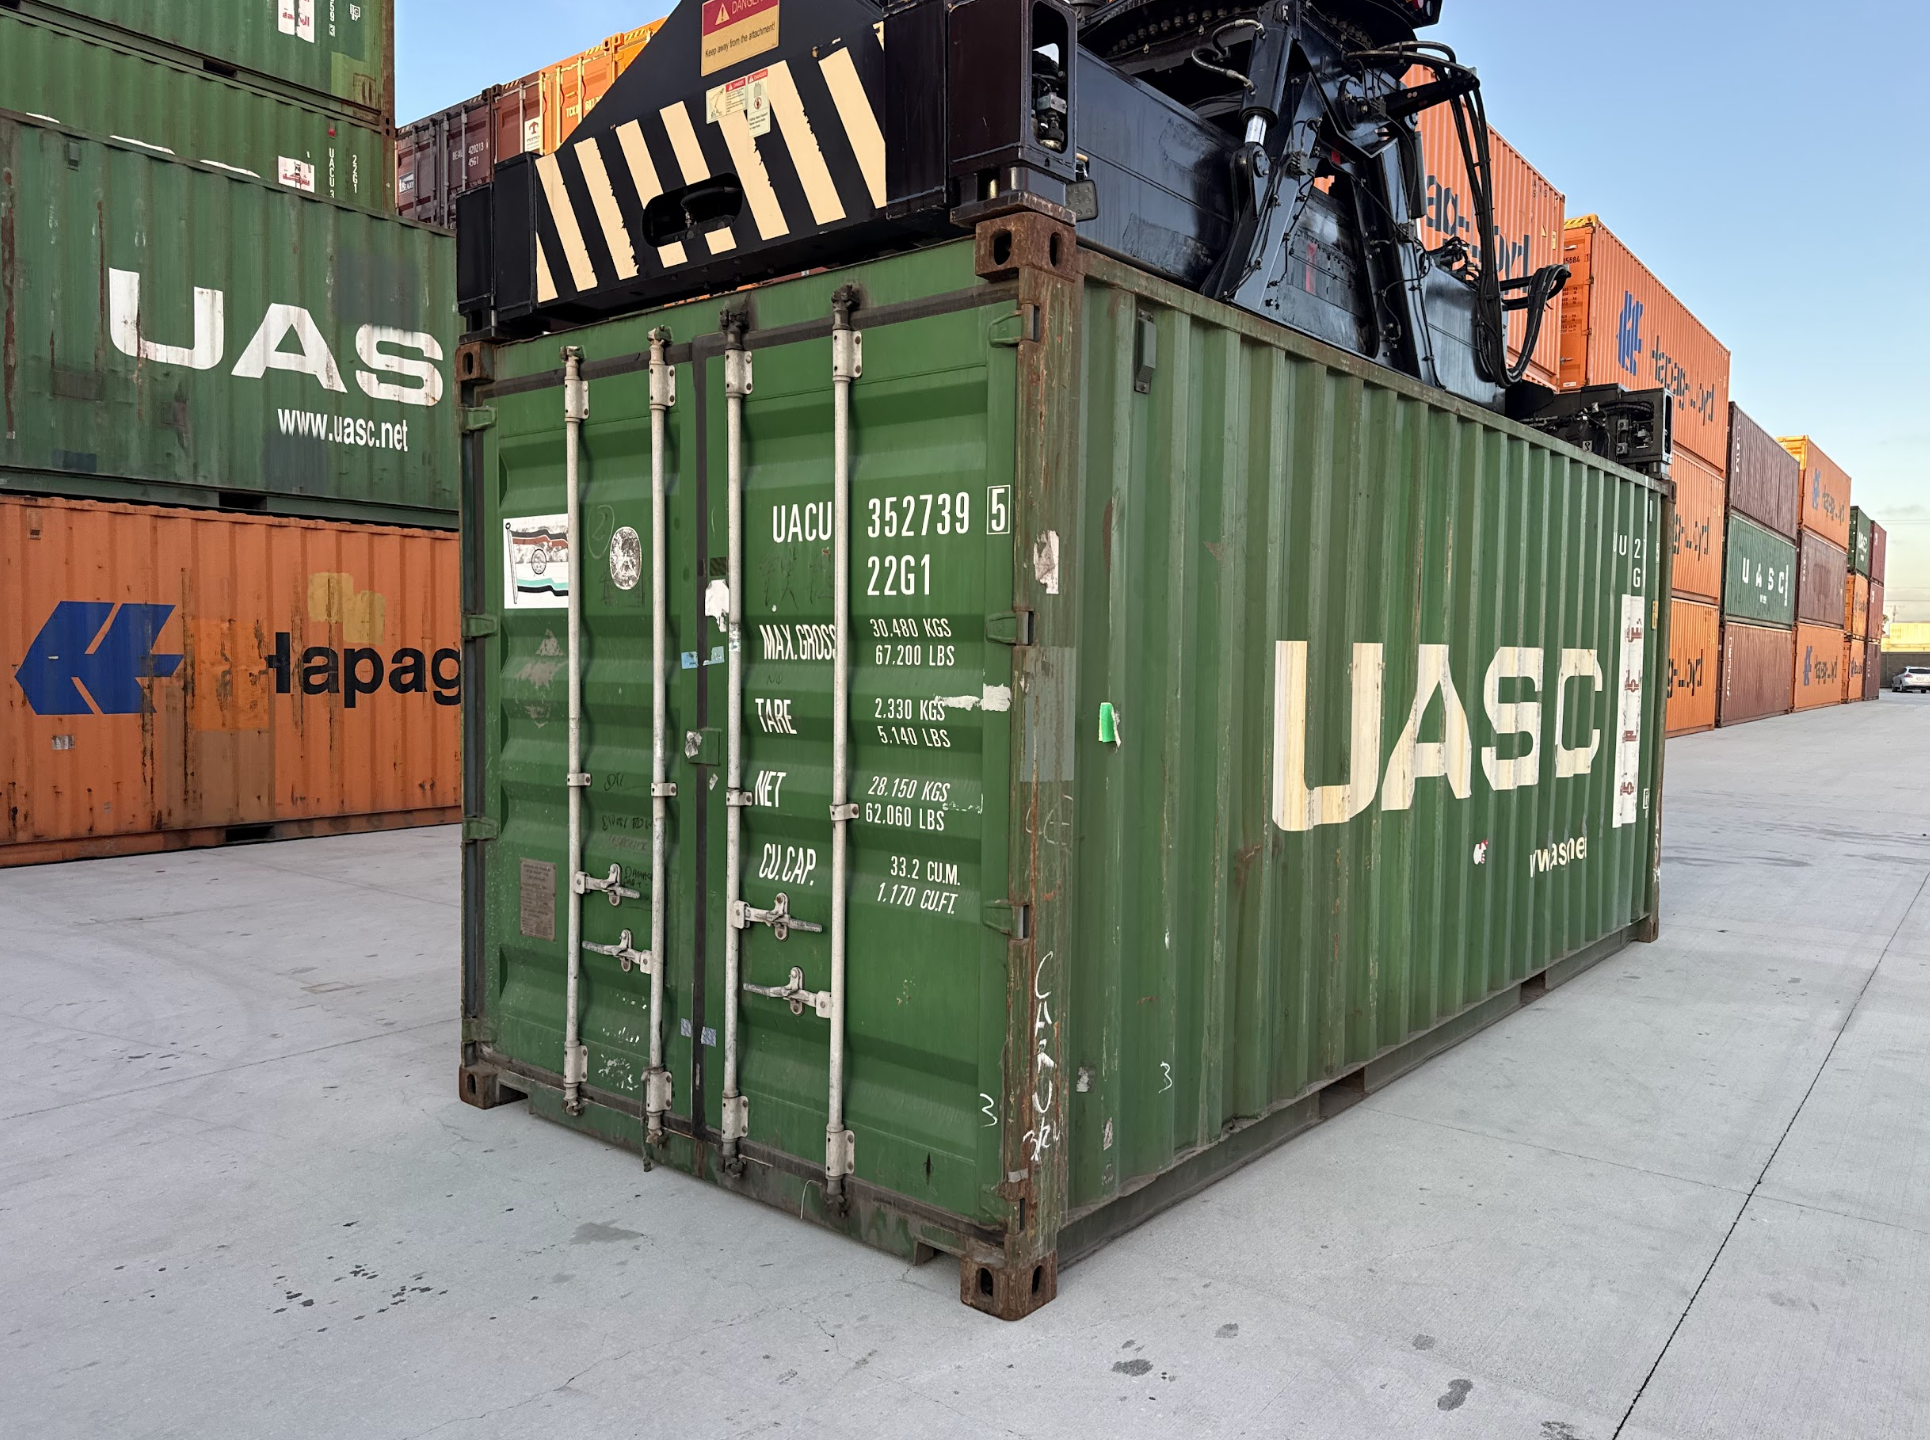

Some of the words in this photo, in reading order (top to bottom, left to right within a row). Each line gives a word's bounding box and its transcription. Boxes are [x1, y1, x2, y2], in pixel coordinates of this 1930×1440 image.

[705, 47, 717, 57] Keep
[717, 42, 729, 52] away
[730, 37, 741, 48] from
[740, 33, 748, 43] the
[277, 408, 407, 452] www.uasc.net
[772, 501, 832, 543] UACU
[867, 491, 970, 538] 352739
[990, 487, 1007, 532] 5
[867, 553, 931, 596] 22G1
[922, 618, 952, 638] KGS
[929, 645, 955, 667] LBS
[754, 698, 798, 735] TARE
[920, 700, 946, 721] KGS
[921, 728, 951, 748] LBS
[1272, 640, 1603, 832] UASC
[754, 770, 787, 808] NET
[921, 780, 951, 802] KGS
[919, 807, 946, 832] LBS
[890, 855, 920, 880] 33.2
